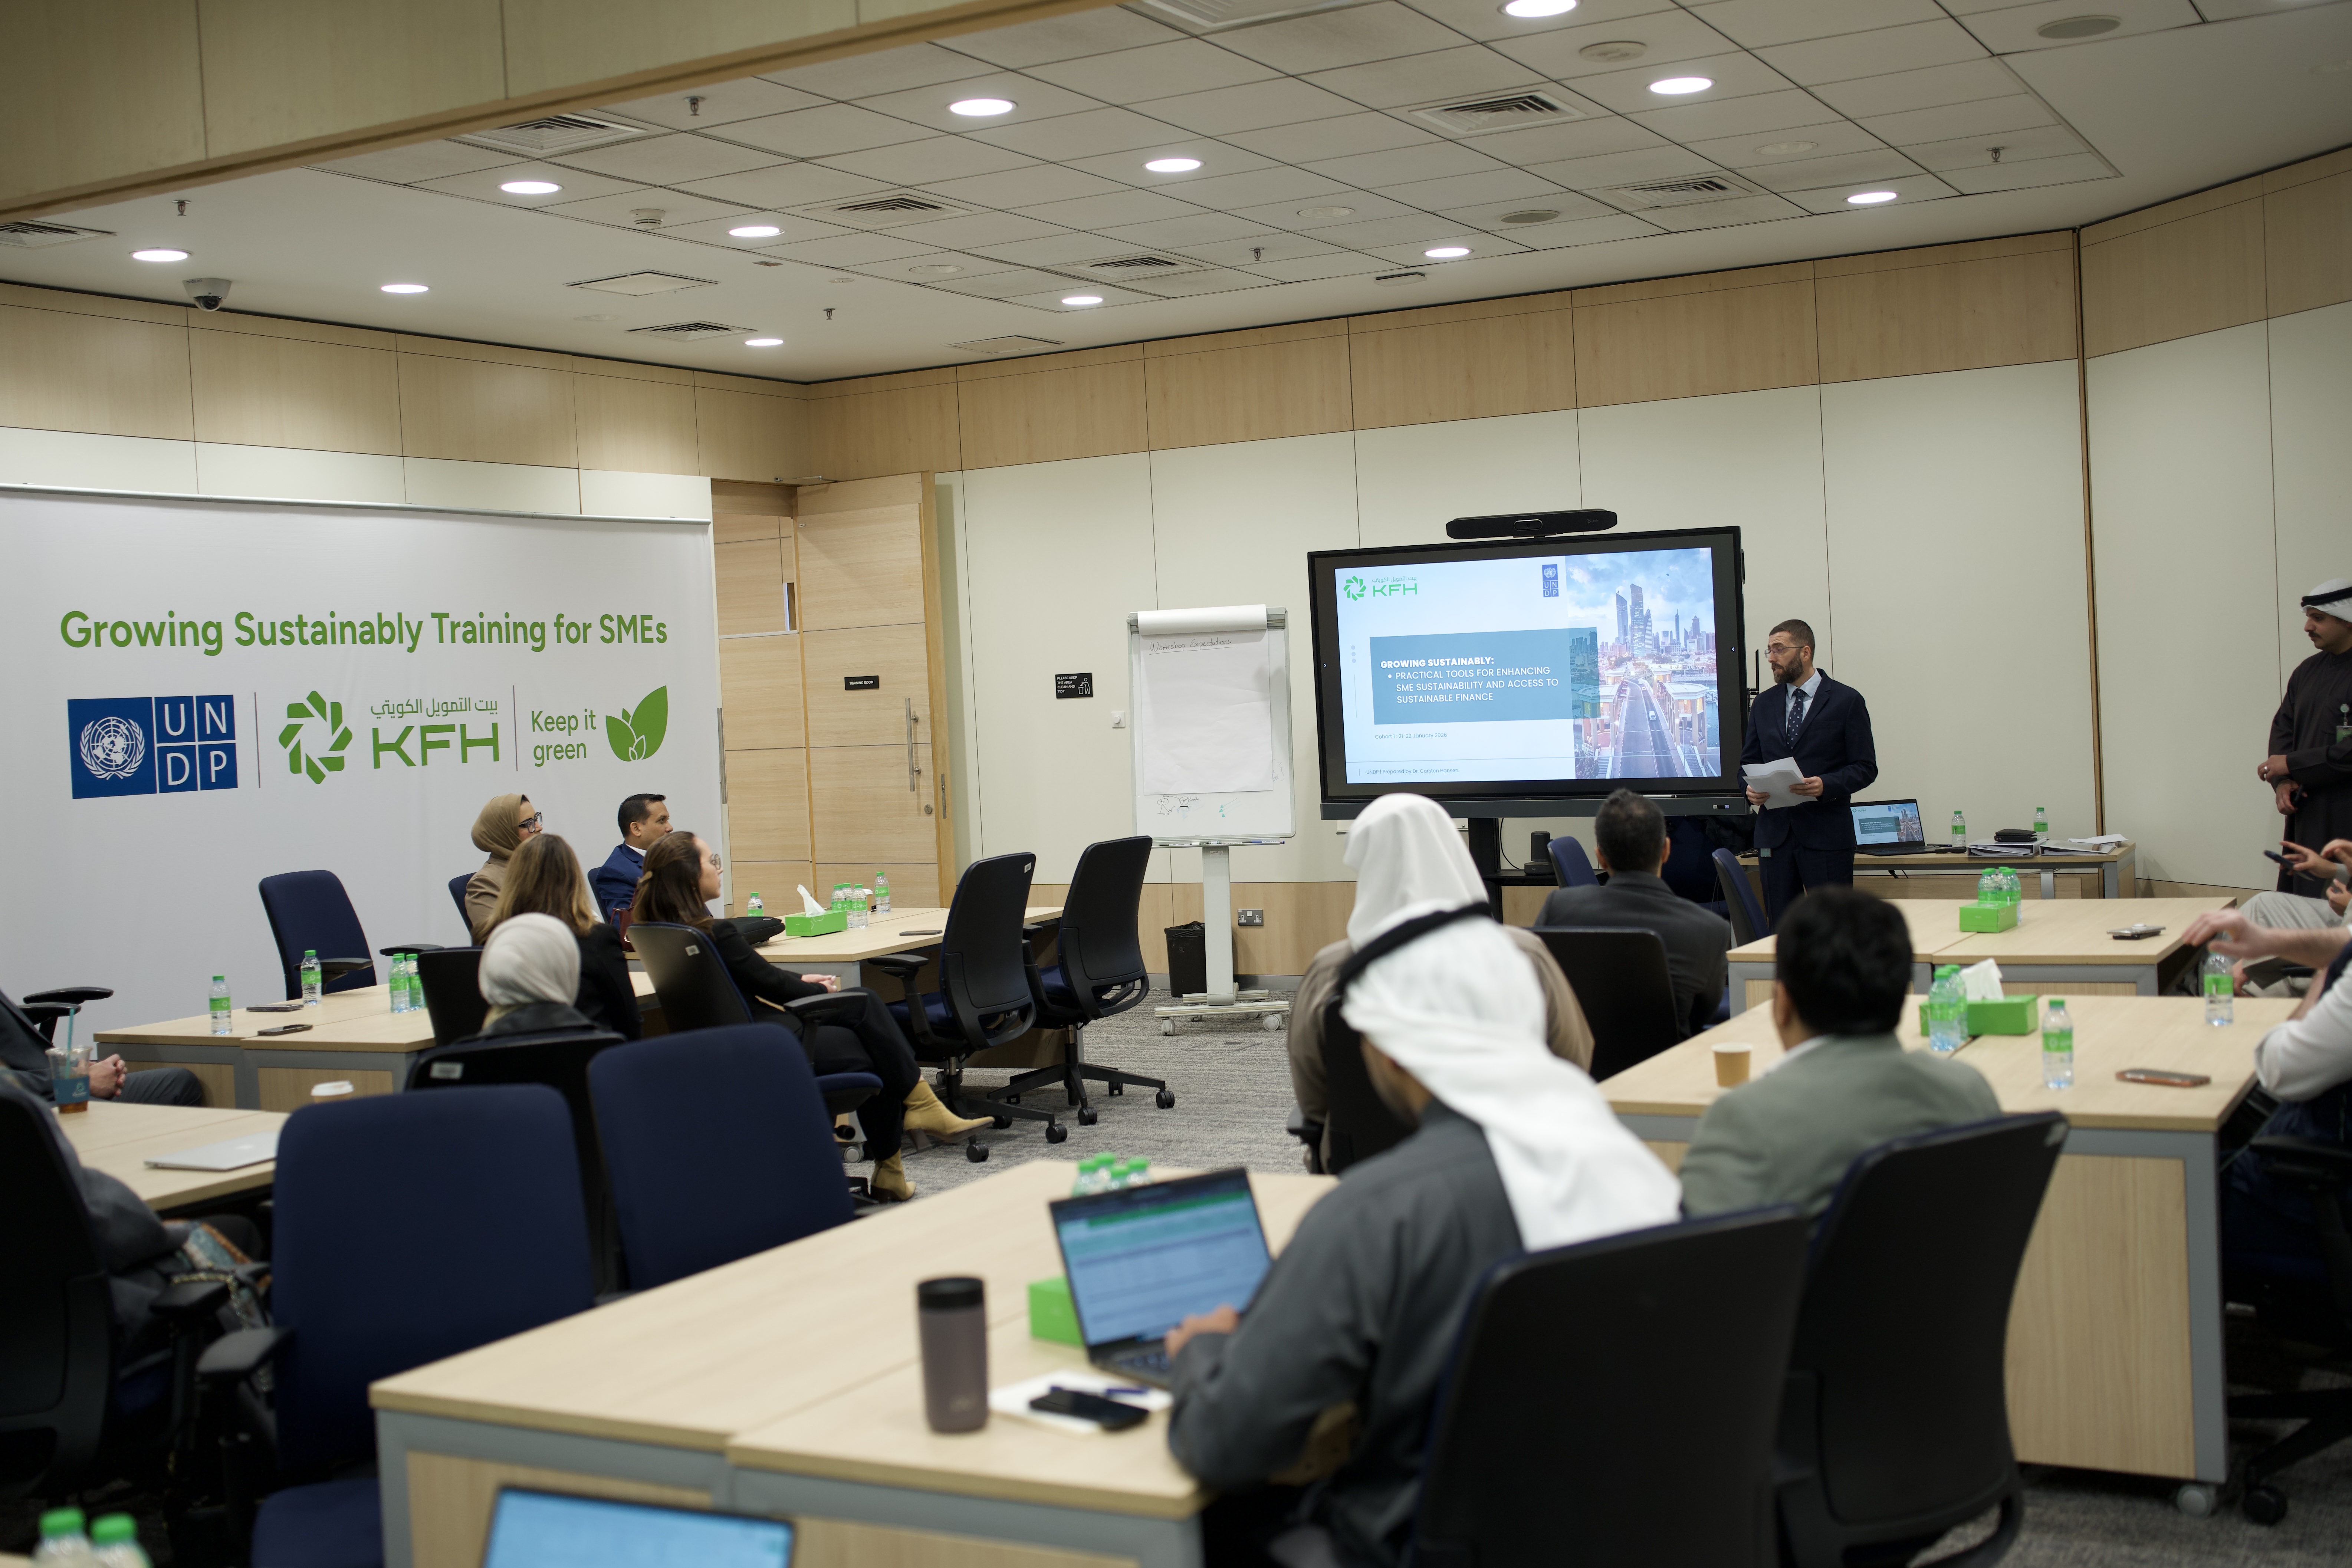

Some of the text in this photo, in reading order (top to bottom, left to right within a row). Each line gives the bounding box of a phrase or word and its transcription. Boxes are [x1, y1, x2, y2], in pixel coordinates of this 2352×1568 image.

[1372, 583, 1417, 597] KFH
[60, 610, 667, 656] Growing Sustainably Training for SMEs
[1150, 637, 1231, 652] Workshop Expectations
[1380, 657, 1494, 668] GROWING SUSTAINABLY:
[1395, 671, 1443, 680] PRACTICAL
[1446, 670, 1474, 678] TOOLS
[1497, 667, 1550, 676] ENHANCING
[1416, 681, 1483, 691] SUSTAINABILITY
[1486, 680, 1505, 688] AND
[1508, 679, 1543, 688] ACCESS
[1397, 693, 1493, 703] SUSTAINABLE FINANCE
[371, 697, 498, 719] بيت التمويل الكويتي
[532, 709, 597, 736] Keep it
[372, 722, 499, 769] KFH
[533, 740, 587, 767] green
